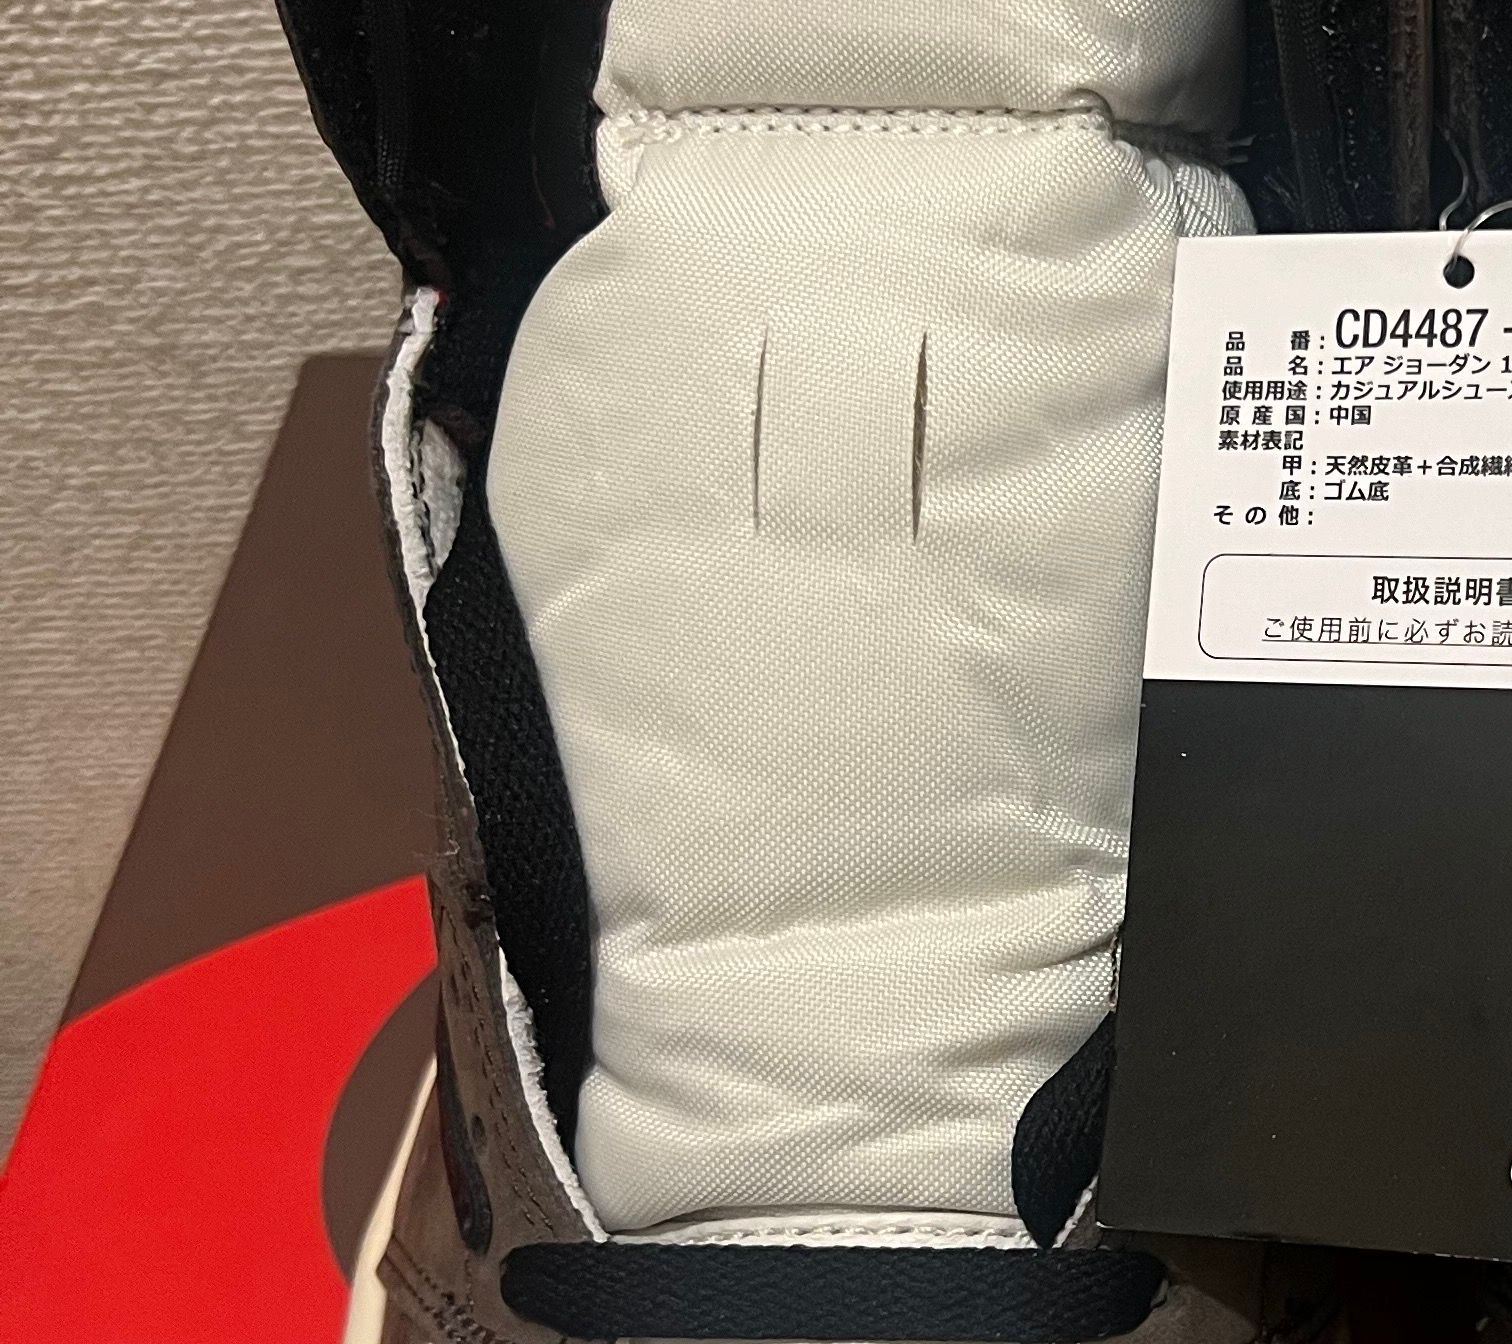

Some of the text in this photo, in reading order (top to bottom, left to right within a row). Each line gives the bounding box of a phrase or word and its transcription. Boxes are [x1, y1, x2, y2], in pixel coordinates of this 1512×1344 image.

[1335, 308, 1489, 350] CD4487
[1331, 356, 1375, 376] エア
[1383, 353, 1492, 376] ジョーダン
[1500, 355, 1512, 374] 1
[1217, 429, 1304, 451] 素材表記
